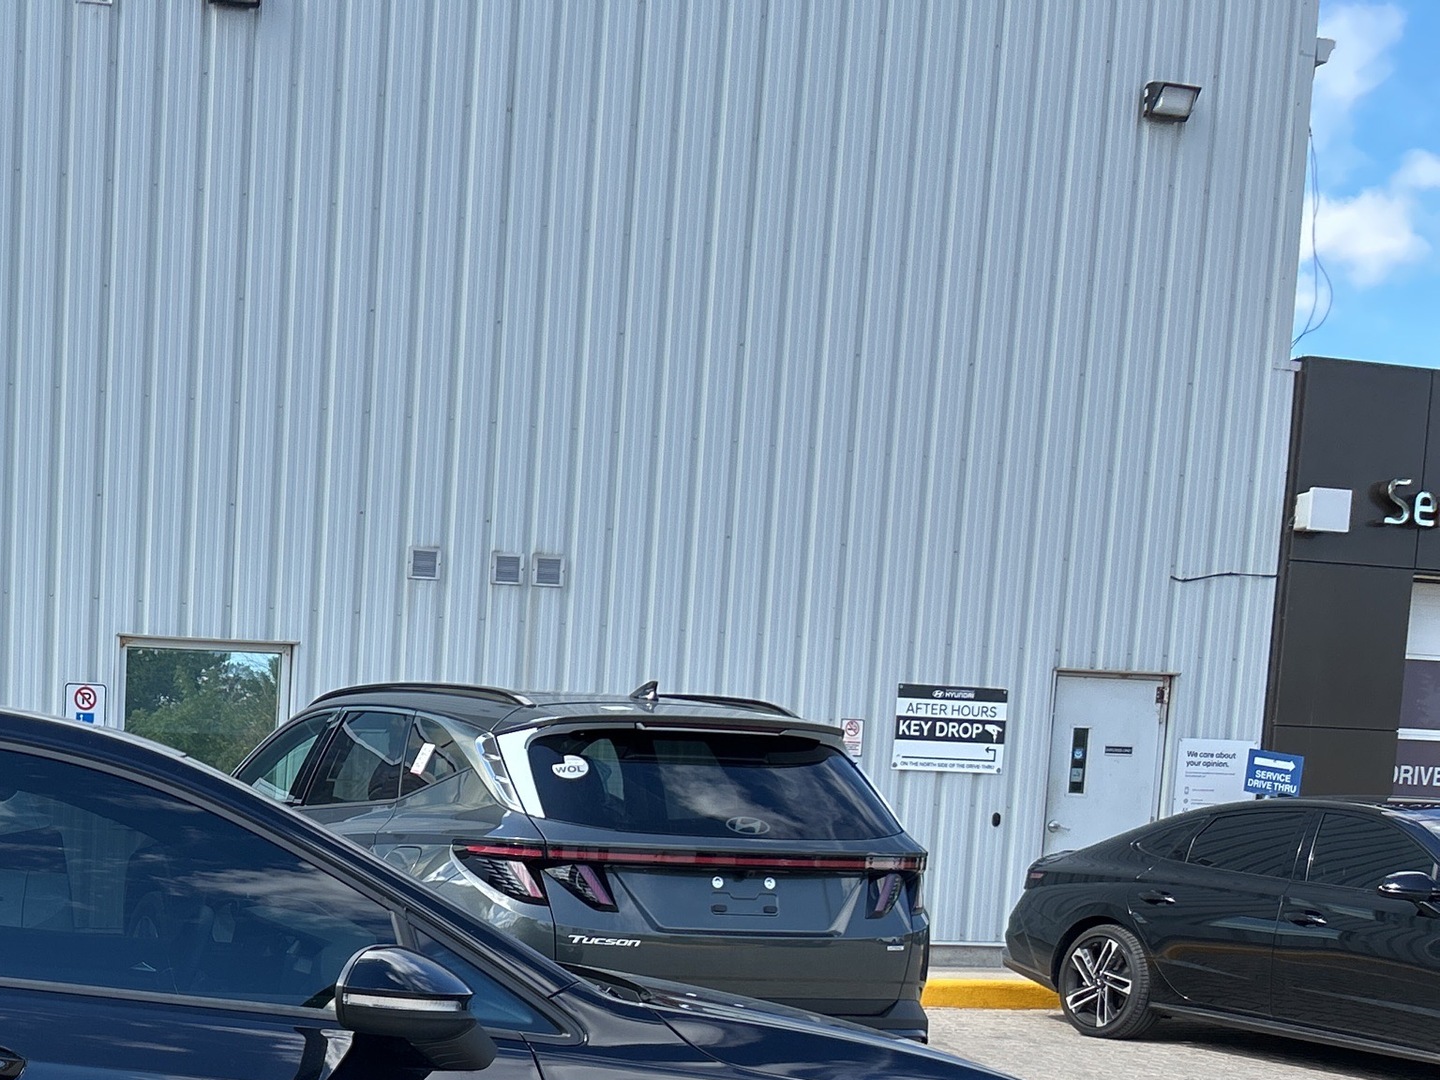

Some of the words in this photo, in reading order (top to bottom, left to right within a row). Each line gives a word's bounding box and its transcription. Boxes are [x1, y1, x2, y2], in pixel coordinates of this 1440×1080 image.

[906, 702, 947, 716] AFTER
[951, 705, 997, 718] HOURS
[898, 719, 933, 736] KEY
[935, 721, 983, 739] DROP
[1187, 750, 1198, 758] We
[555, 765, 585, 774] WOL
[1255, 769, 1291, 783] SERVICE
[1247, 778, 1272, 790] DRIVE
[1273, 781, 1297, 794] THRU
